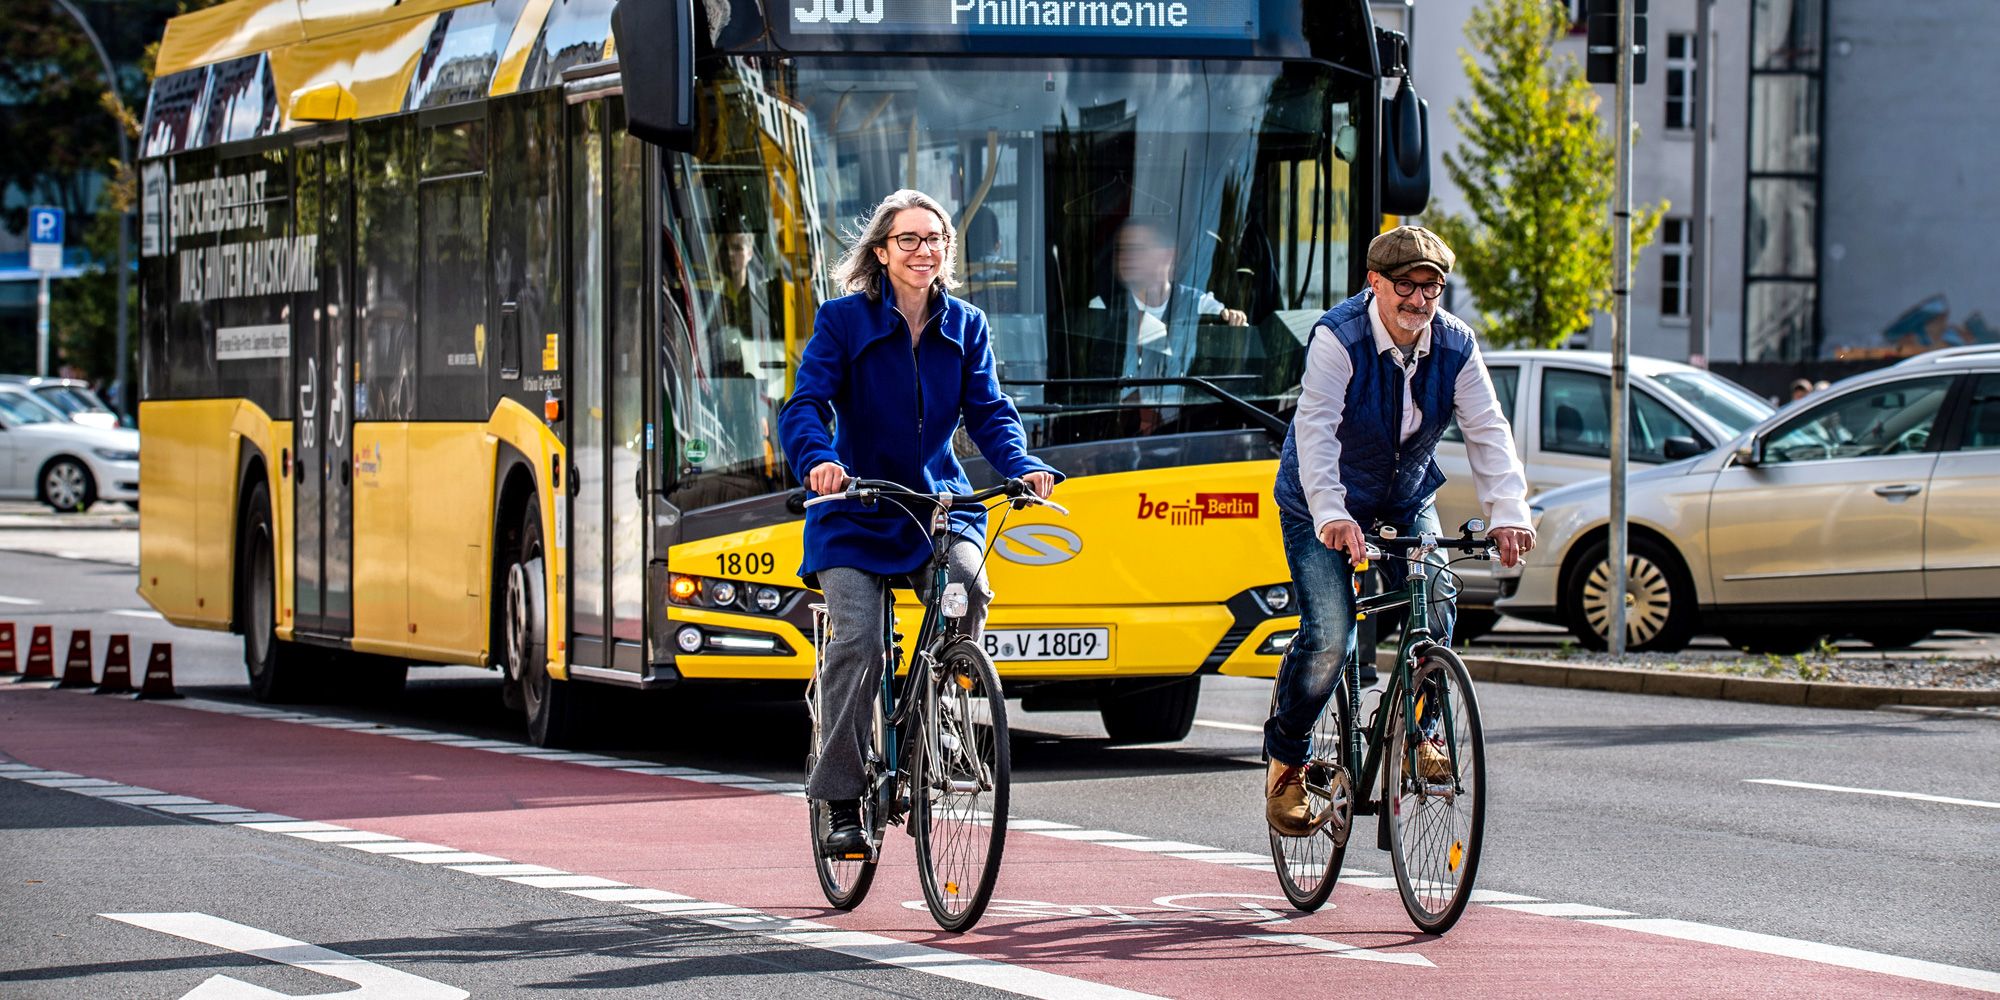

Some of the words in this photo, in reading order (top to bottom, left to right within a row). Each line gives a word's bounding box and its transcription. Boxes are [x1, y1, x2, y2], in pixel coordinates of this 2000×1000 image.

[951, 0, 1188, 27] Philharmonie
[171, 174, 248, 238] ENTSCHEIDEND
[250, 170, 268, 233] IST,
[180, 247, 204, 302] WAS
[204, 242, 244, 300] HINTEN
[245, 234, 318, 296] RAUSKOMMT.
[1137, 493, 1169, 520] be
[1207, 498, 1254, 514] Berlin
[716, 552, 775, 576] 1809
[984, 634, 999, 657] B
[1016, 633, 1031, 656] V
[1037, 632, 1097, 656] 1809
